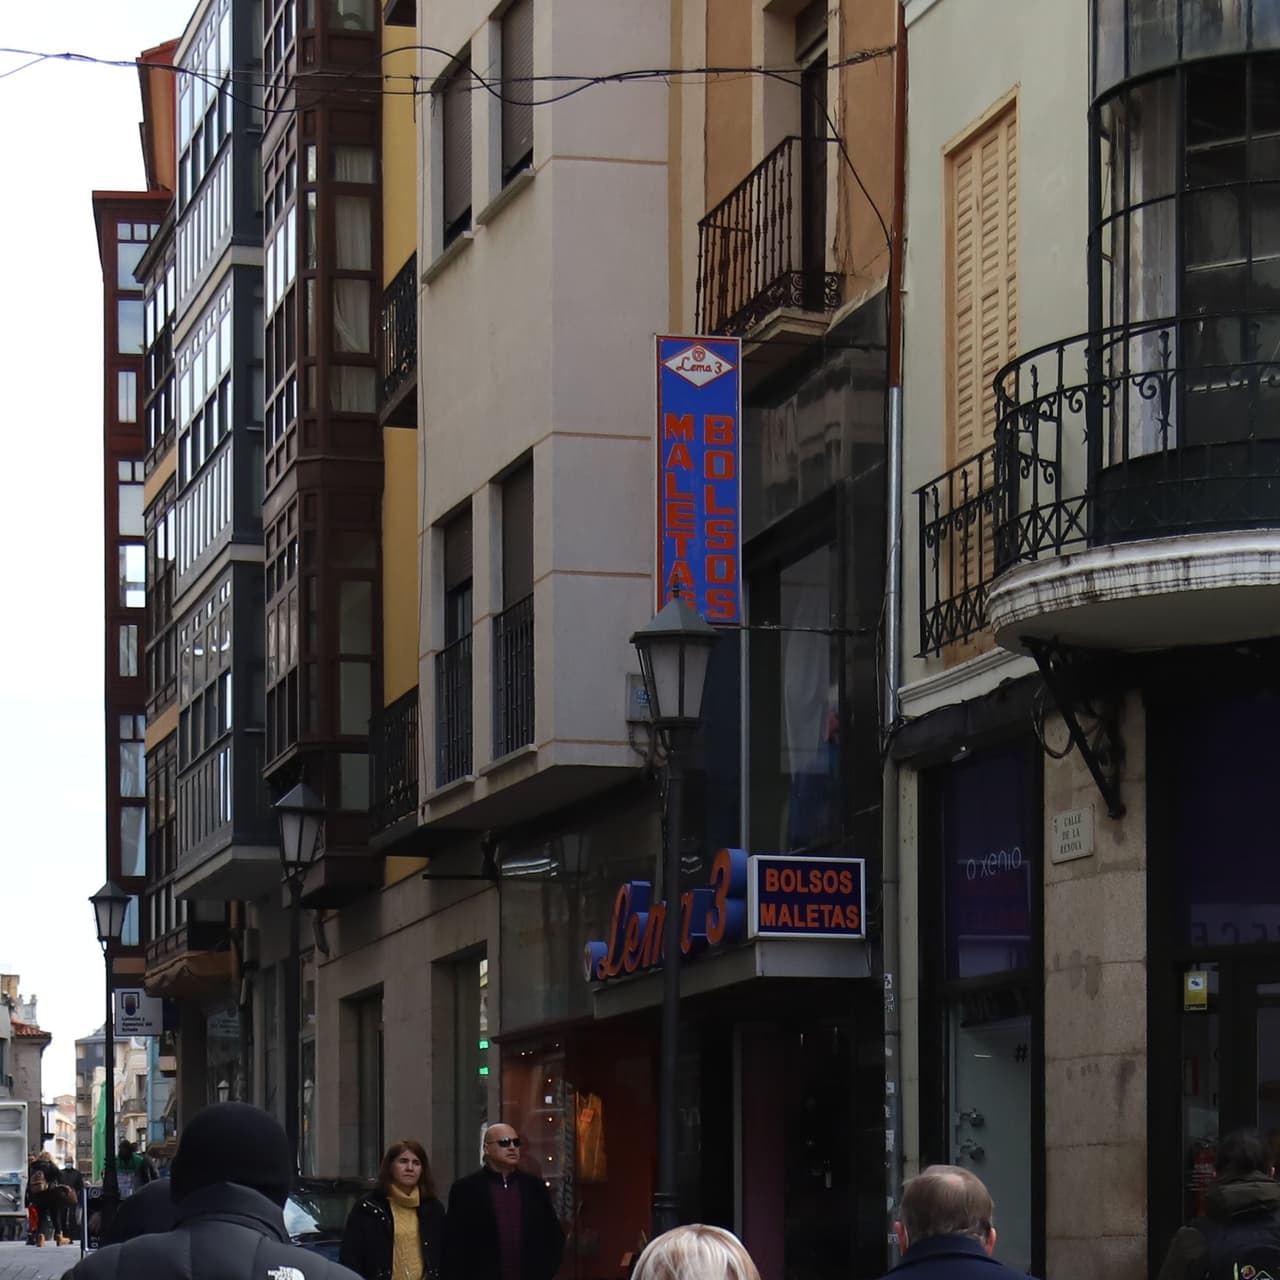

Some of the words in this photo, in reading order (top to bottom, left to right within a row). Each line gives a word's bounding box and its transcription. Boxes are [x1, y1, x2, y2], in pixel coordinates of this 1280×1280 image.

[675, 356, 713, 373] Lema
[714, 361, 723, 375] 3
[704, 414, 736, 619] BOLSOS
[980, 847, 1022, 879] xenio
[765, 867, 853, 895] BOLSOS
[706, 848, 732, 945] 3
[760, 903, 860, 929] MALETAS
